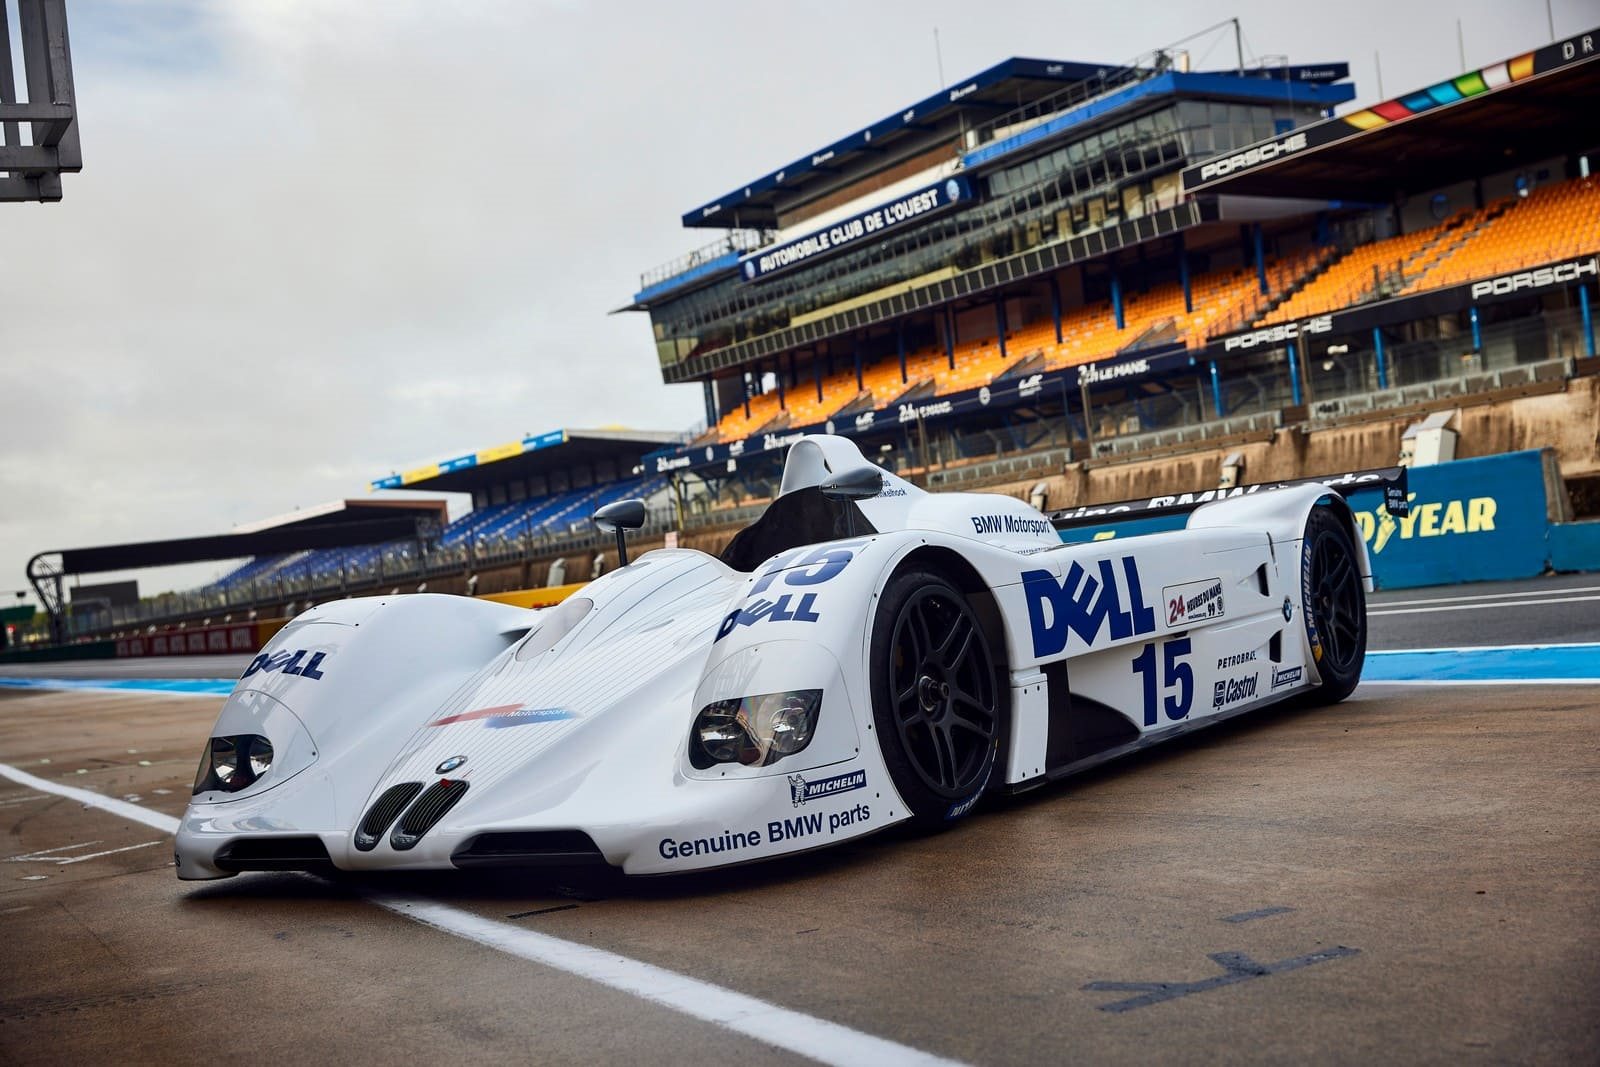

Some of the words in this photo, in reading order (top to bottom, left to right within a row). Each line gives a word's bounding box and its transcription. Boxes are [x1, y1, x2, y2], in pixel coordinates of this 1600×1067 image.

[1201, 132, 1307, 181] PORSCHE
[760, 234, 831, 273] AUTOMOBILE
[830, 218, 864, 246] CLUB
[864, 212, 884, 232] DE
[883, 188, 938, 225] L'OUEST
[1225, 314, 1333, 352] PORSCHE
[971, 516, 1001, 534] BMW
[1004, 514, 1050, 536] Motorsport
[747, 541, 860, 599] 15
[1303, 545, 1316, 628] MICHELIN
[713, 593, 820, 645] DELL
[1021, 556, 1156, 659] DELL
[1169, 594, 1185, 624] 24
[1208, 602, 1215, 616] 99
[240, 649, 327, 681] DELL
[1132, 638, 1194, 727] 15
[1278, 670, 1301, 681] MICHELIN
[1226, 671, 1258, 703] Castrol
[808, 772, 864, 795] MICHELIN
[658, 830, 761, 859] Genuine
[768, 812, 823, 843] BMW
[829, 803, 870, 834] parts
